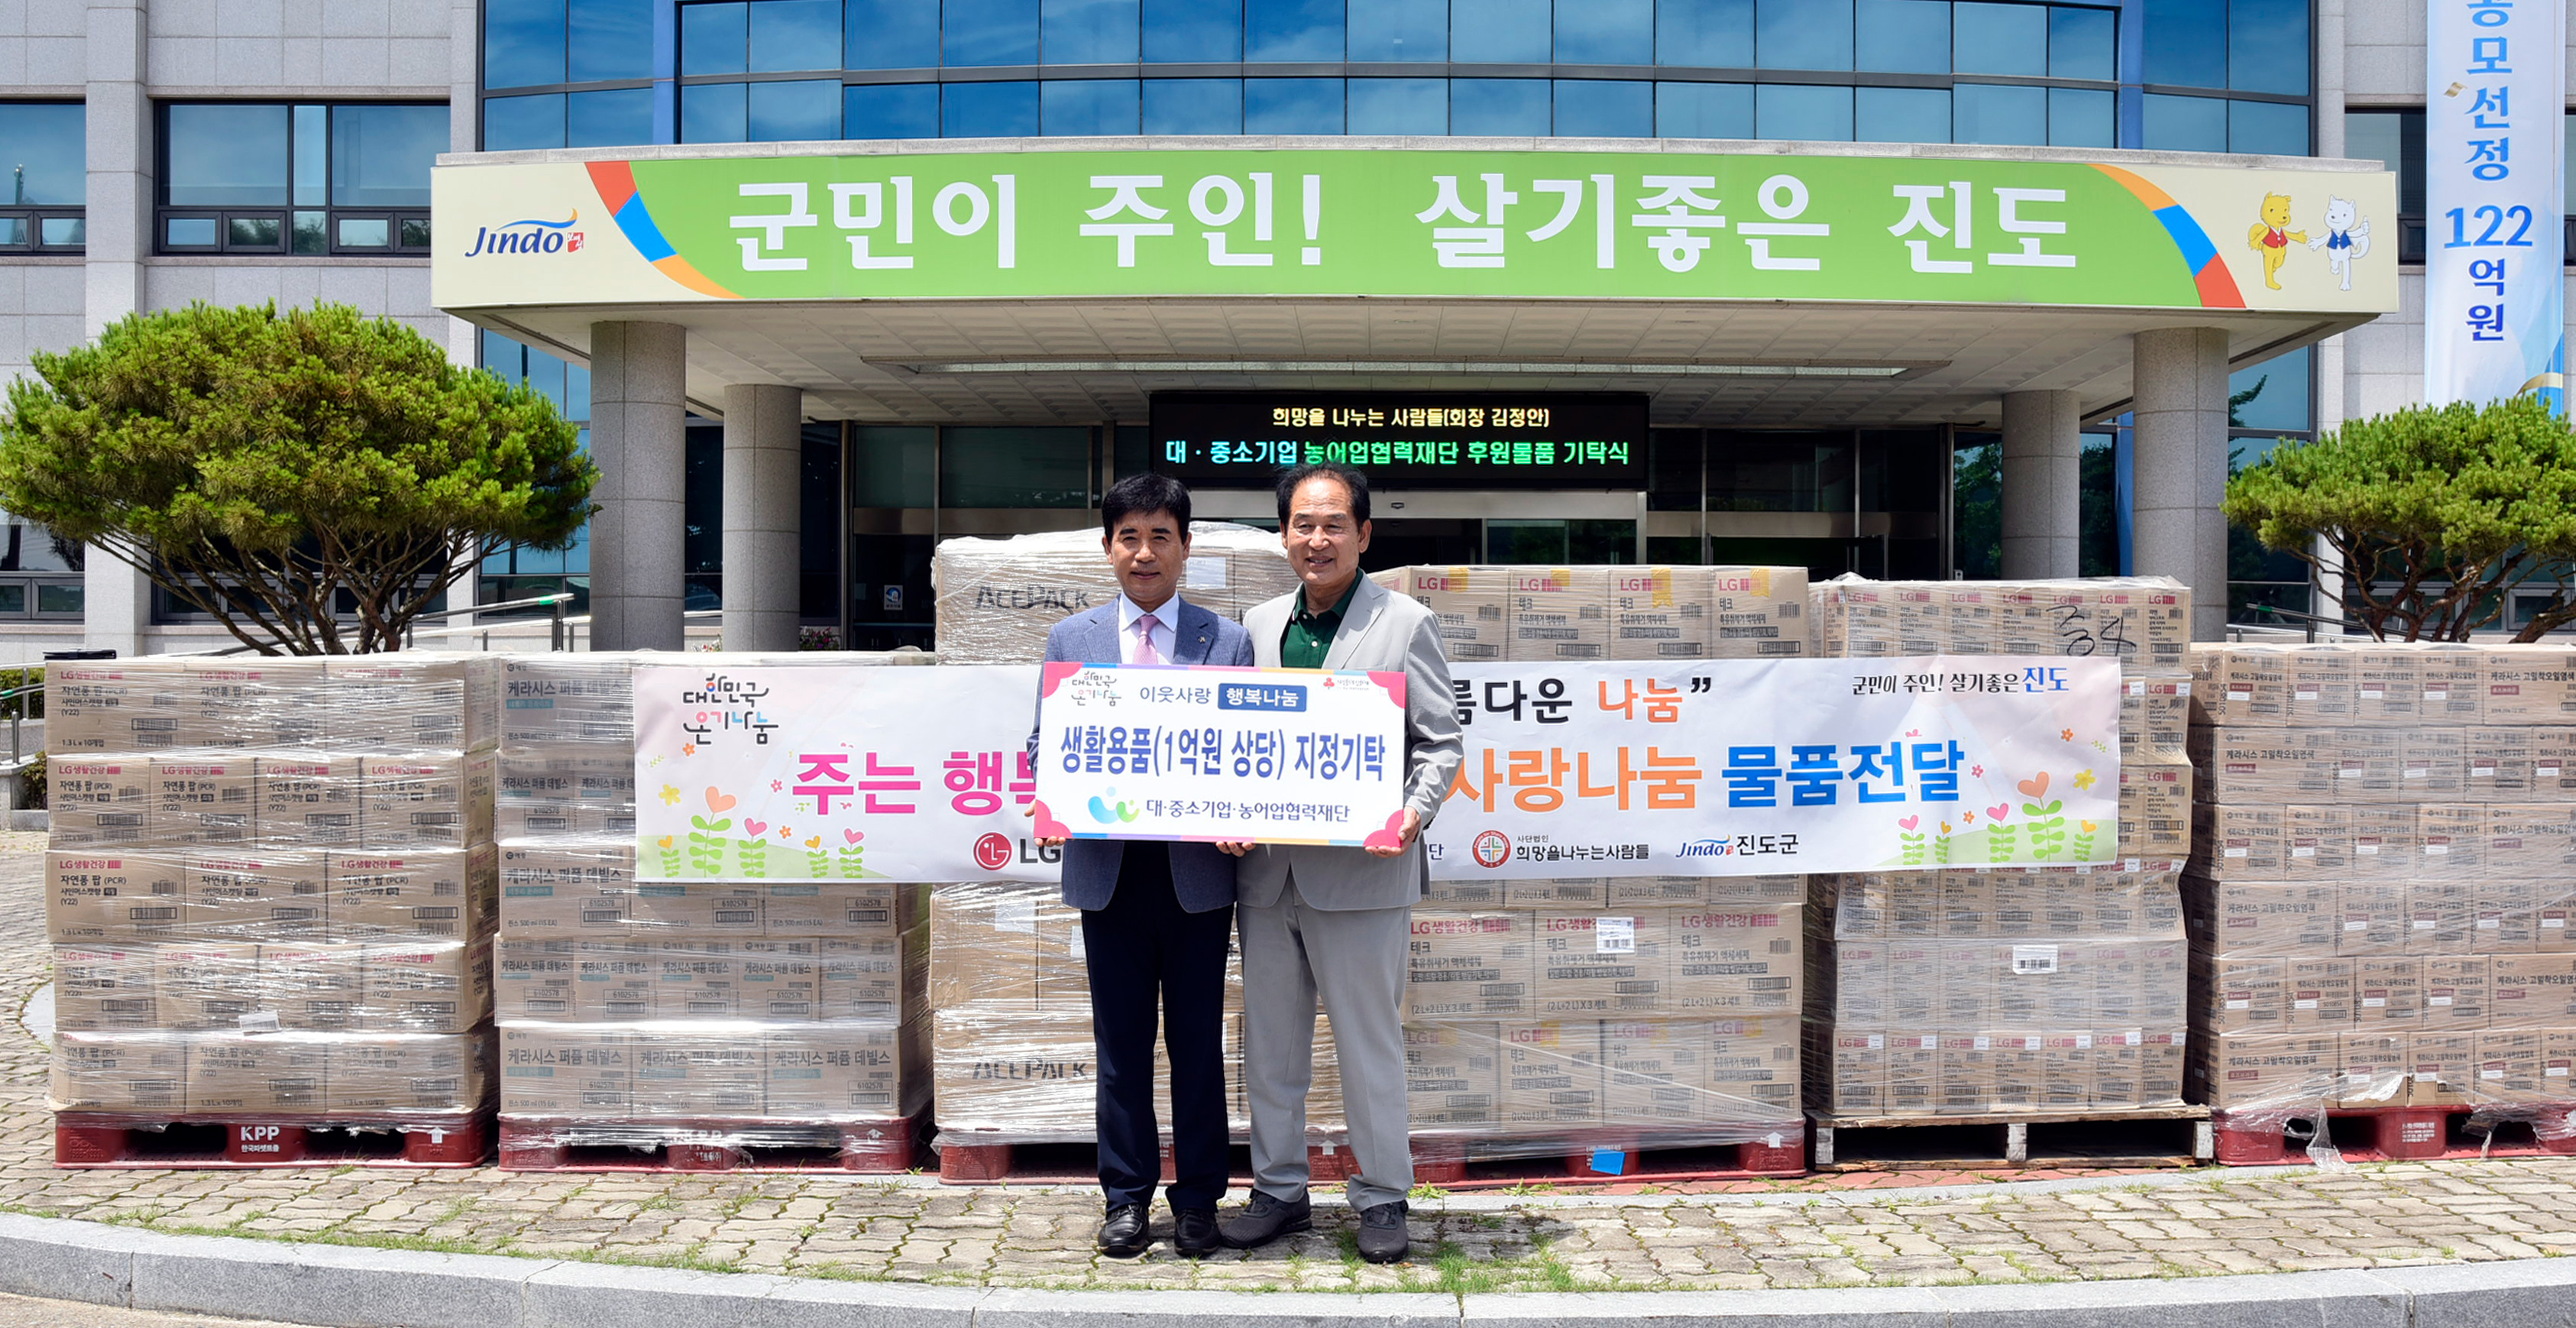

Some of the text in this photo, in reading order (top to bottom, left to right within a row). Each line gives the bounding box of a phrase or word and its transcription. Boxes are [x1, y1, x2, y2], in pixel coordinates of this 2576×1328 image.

[730, 172, 2076, 274] 군민이 주인! 살기좋은 진도
[2444, 205, 2533, 248] 122
[464, 227, 564, 257] Jindo
[2465, 258, 2506, 342] 억원
[1272, 408, 1325, 426] 희망을
[1332, 408, 1384, 426] 나누는
[1490, 408, 1549, 427] 김정안)
[1166, 440, 1628, 465] 대 중소기업 농어업협력재단 후원물품 기탁식
[1418, 577, 1438, 591] LG
[1519, 578, 1539, 591] LG
[1620, 578, 1639, 591] LG
[1719, 578, 1738, 591] LG
[1848, 593, 1861, 601] LG
[1901, 593, 1914, 601] LG
[2149, 595, 2161, 604] LG
[1852, 667, 2070, 695] 군민이 주인! 살기좋은 진도
[2149, 685, 2162, 694] LG
[1140, 686, 1299, 708] 이웃사랑 행복나눔
[1061, 724, 1386, 782] 생활용품(1억원 상당) 지정기탁
[59, 766, 72, 775] LG
[162, 766, 176, 775] LG
[1722, 740, 1965, 808] 물품전달
[792, 752, 921, 815] 주는
[1675, 834, 1798, 857] Jindo 진도군
[1516, 844, 1649, 862] 희망을나누는사람들
[60, 860, 73, 869] LG
[2144, 862, 2158, 870] LG
[1411, 920, 1479, 934] LG 생활건강
[1547, 919, 1566, 931] LG
[1682, 913, 1748, 928] LG 생활건강
[1411, 941, 1431, 954] 테크
[1714, 1022, 1733, 1035] LG
[1511, 1030, 1530, 1042] LG
[1839, 1038, 1852, 1047] LG
[2144, 1035, 2156, 1044] LG
[241, 1126, 280, 1141] KPP
